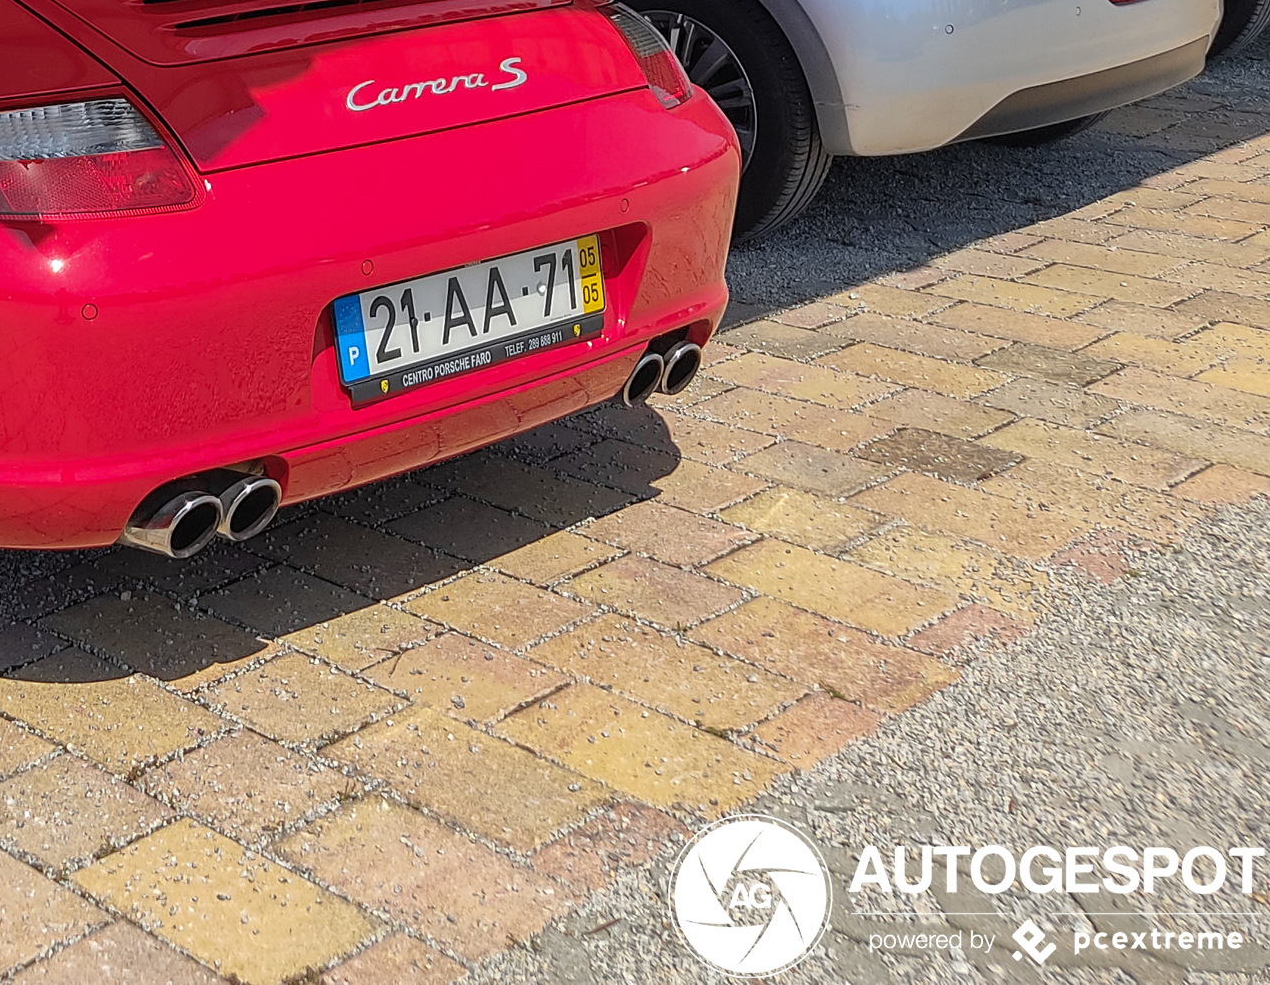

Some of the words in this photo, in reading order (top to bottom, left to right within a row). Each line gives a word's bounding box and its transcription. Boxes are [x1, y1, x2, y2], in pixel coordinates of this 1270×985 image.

[346, 73, 489, 112] Carrera
[491, 57, 528, 92] S
[579, 245, 596, 268] 05
[582, 282, 599, 304] 05
[348, 346, 360, 366] P
[402, 367, 434, 387] CENTRO
[434, 357, 470, 378] PORSCHE
[471, 350, 492, 368] FARO
[504, 341, 527, 357] TELEF.
[551, 330, 563, 344] 911
